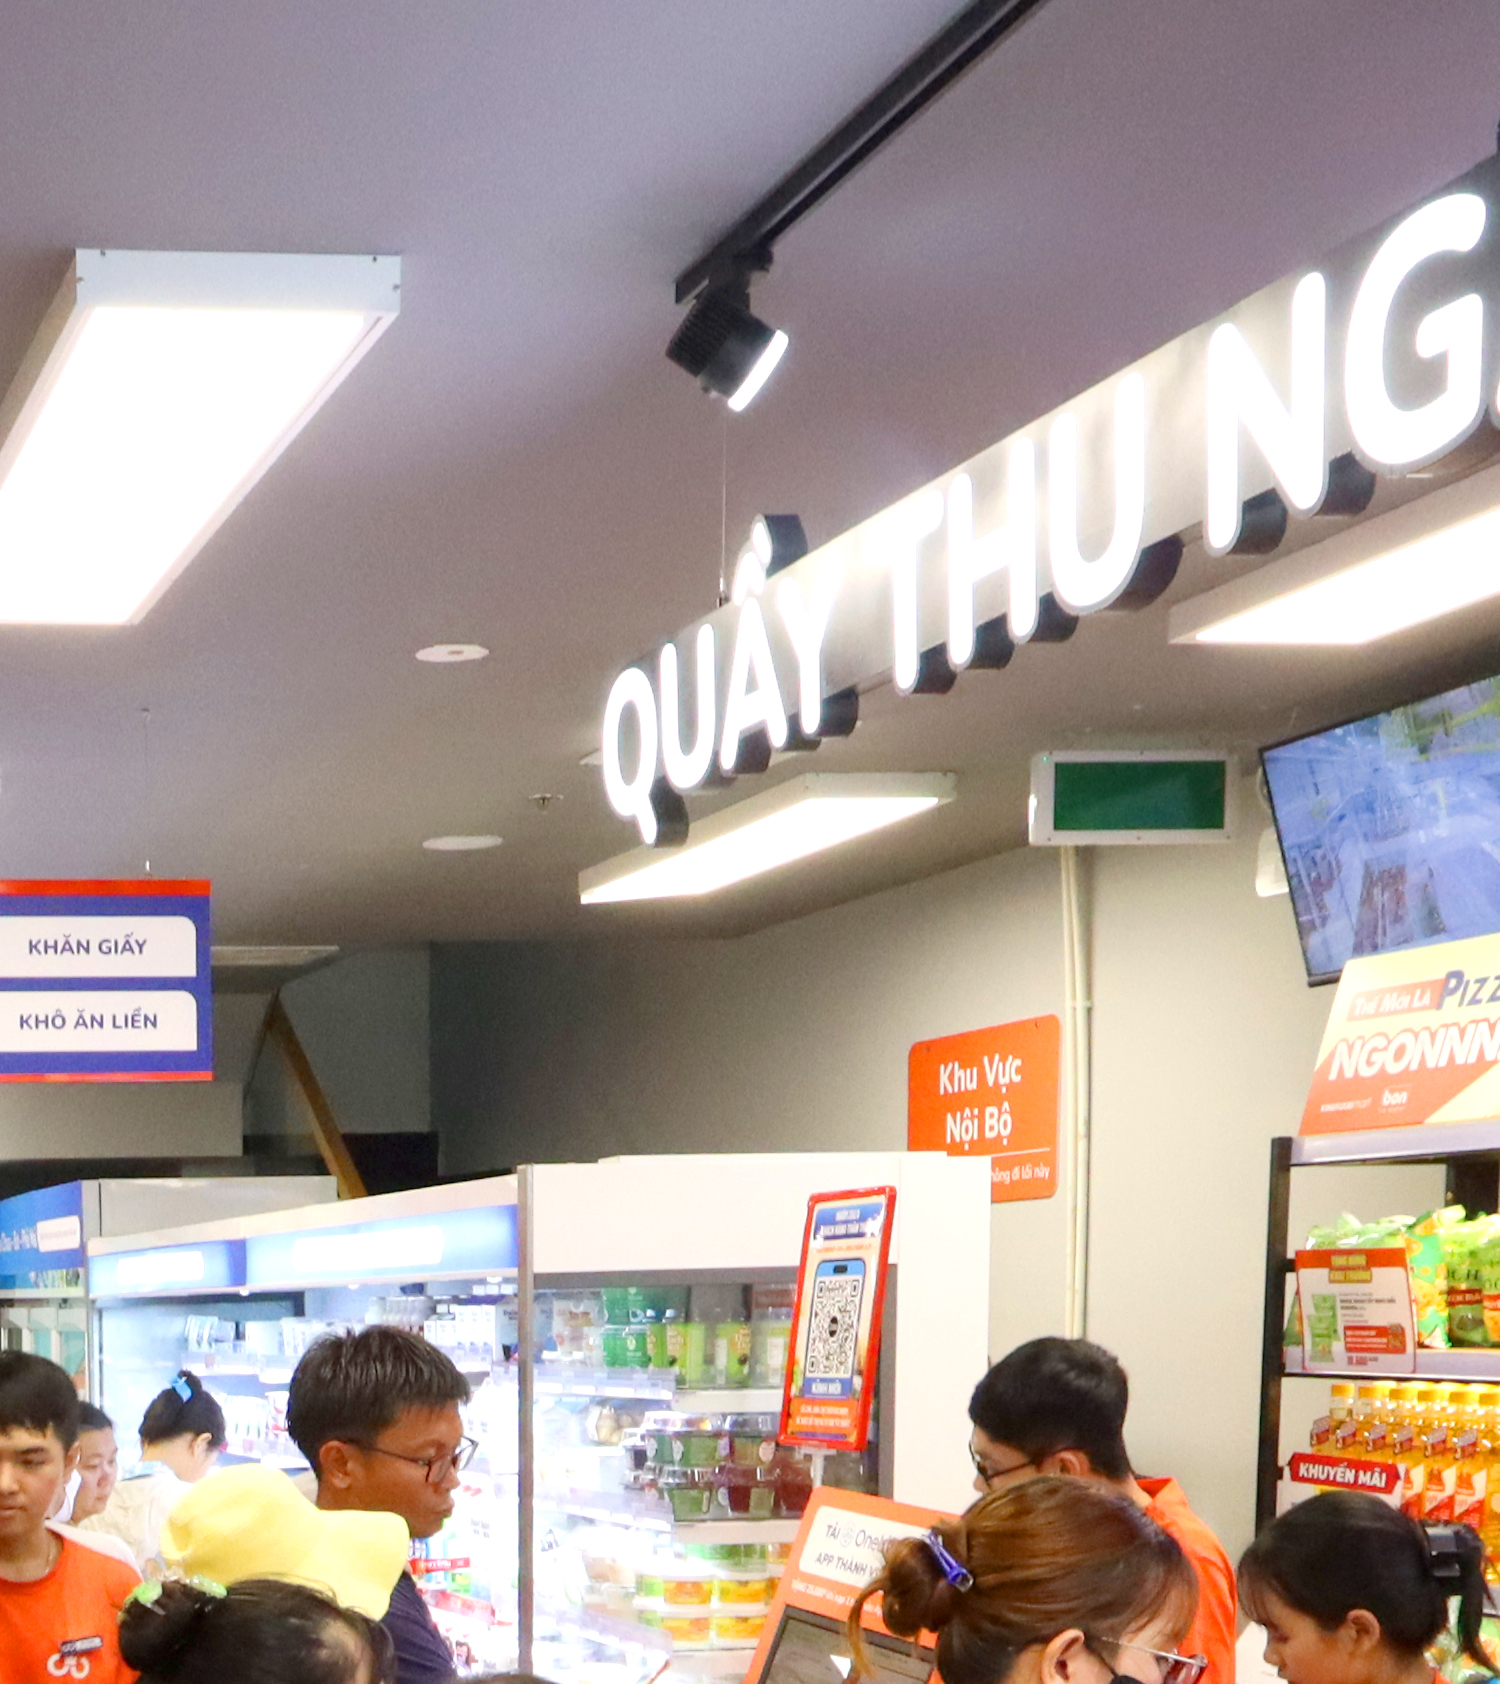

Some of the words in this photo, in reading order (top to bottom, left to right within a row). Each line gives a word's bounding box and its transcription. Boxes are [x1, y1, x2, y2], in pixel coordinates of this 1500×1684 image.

[888, 358, 1150, 697] THU
[28, 937, 91, 957] KHĂN
[98, 932, 147, 956] GIẤY
[19, 1009, 66, 1031] KHÔ
[74, 1010, 107, 1031] ĂN
[113, 1006, 158, 1031] LIỀN
[939, 1061, 978, 1095] Khu
[984, 1053, 1022, 1094] Vực
[946, 1107, 979, 1150] Nội
[984, 1101, 1012, 1145] Bộ
[1299, 1461, 1355, 1485] KHUYẾN
[1357, 1468, 1387, 1487] MÃI
